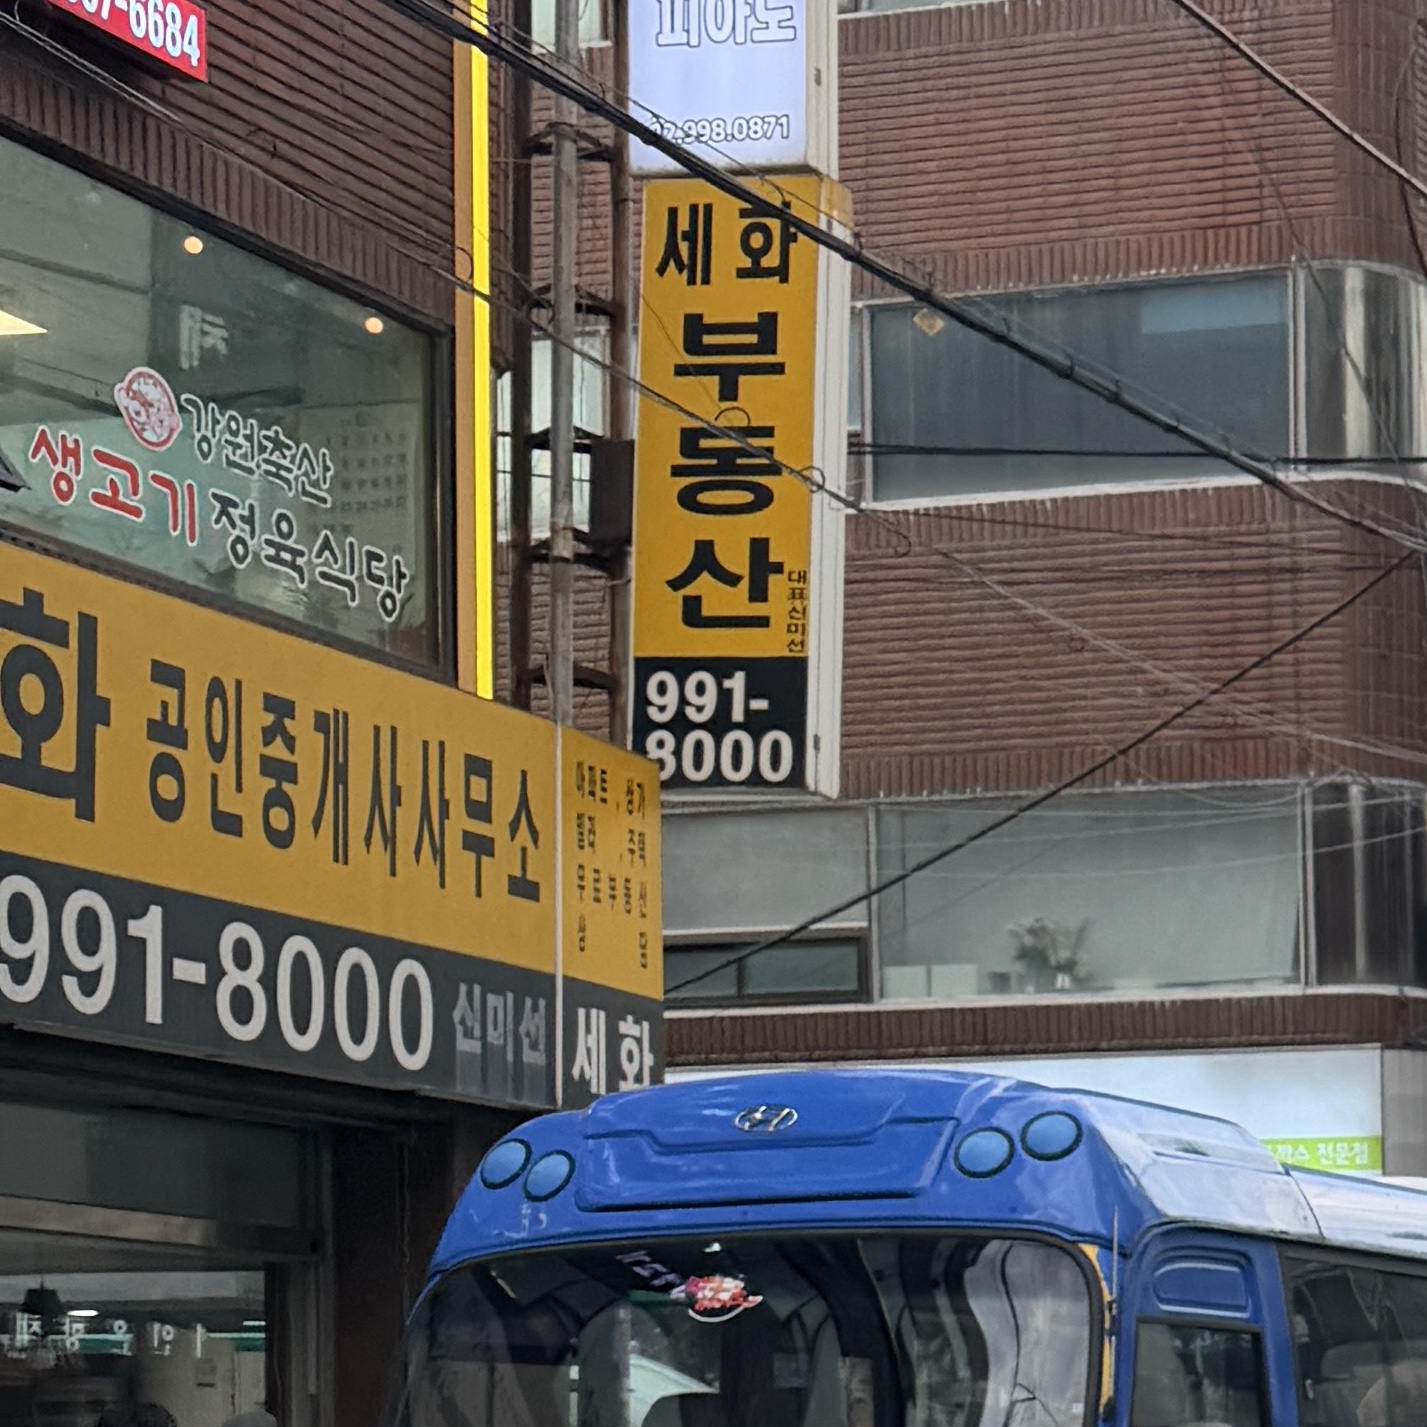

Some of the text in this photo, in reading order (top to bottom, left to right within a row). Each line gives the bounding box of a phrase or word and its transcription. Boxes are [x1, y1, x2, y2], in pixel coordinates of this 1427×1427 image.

[655, 201, 798, 286] 세화
[29, 425, 198, 546] 생고기
[209, 489, 410, 622] 정육식당
[181, 393, 333, 507] 강원축산
[664, 311, 786, 630] 부동산
[645, 671, 769, 725] 991-
[646, 730, 794, 783] 8000
[147, 657, 541, 903] 공인중개사사무소
[0, 874, 547, 1072] 991-8000 신미선
